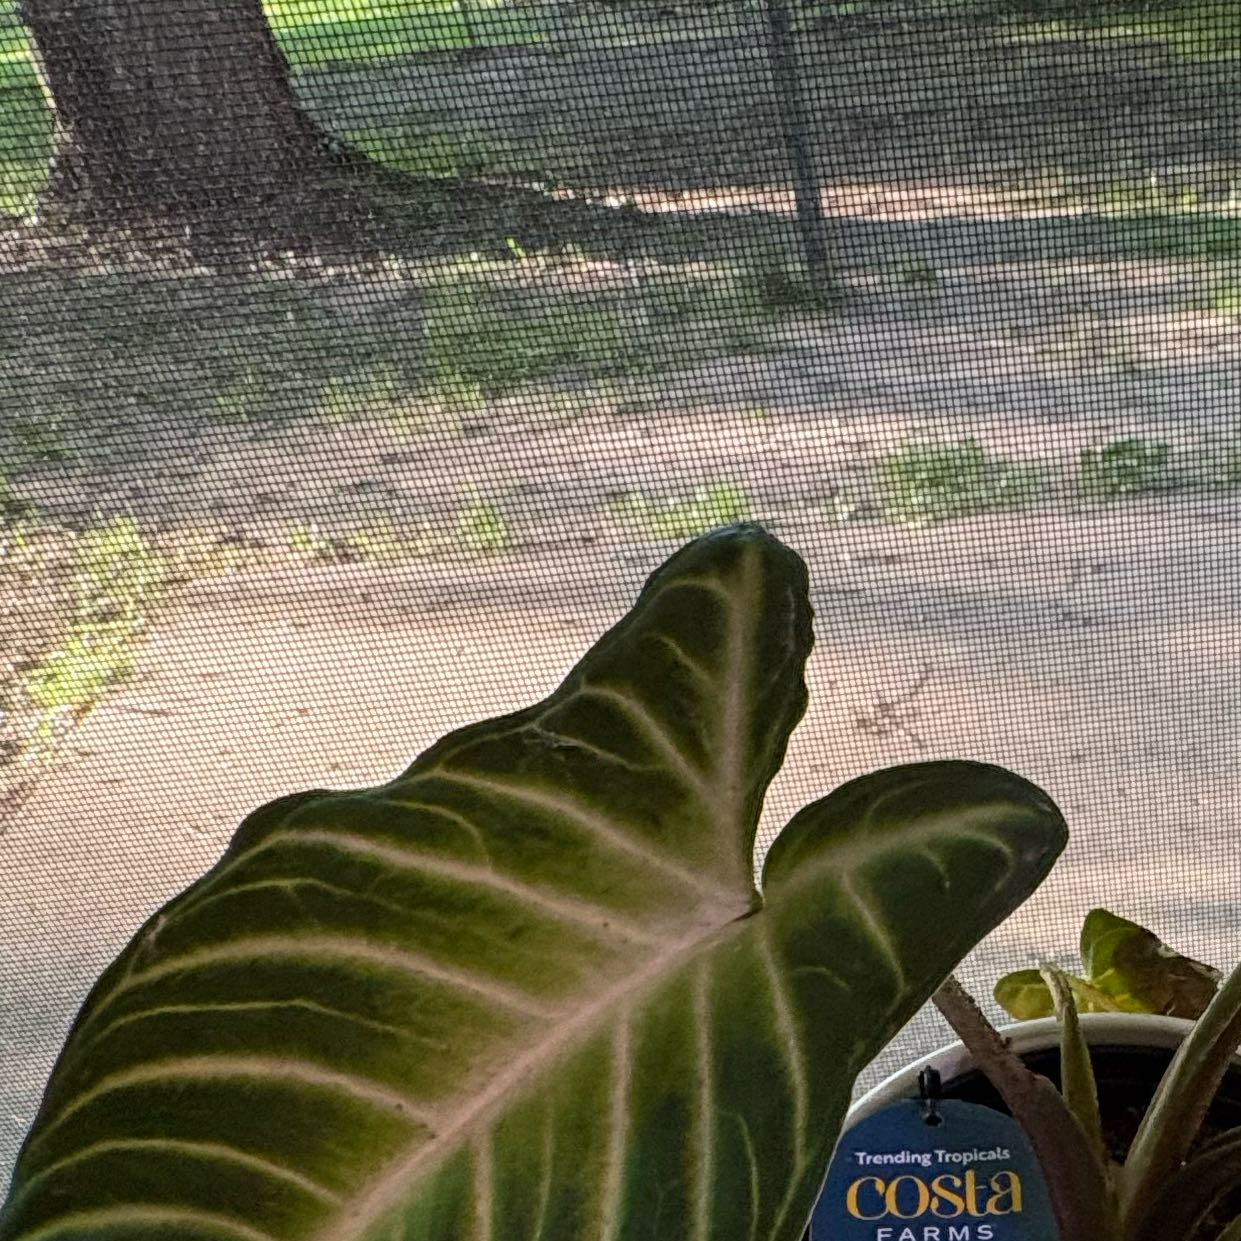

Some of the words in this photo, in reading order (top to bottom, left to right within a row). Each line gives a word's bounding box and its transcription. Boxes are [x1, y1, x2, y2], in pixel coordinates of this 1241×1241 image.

[855, 1151, 932, 1167] Trending
[934, 1147, 1010, 1166] Tropicals
[846, 1169, 1022, 1220] costa
